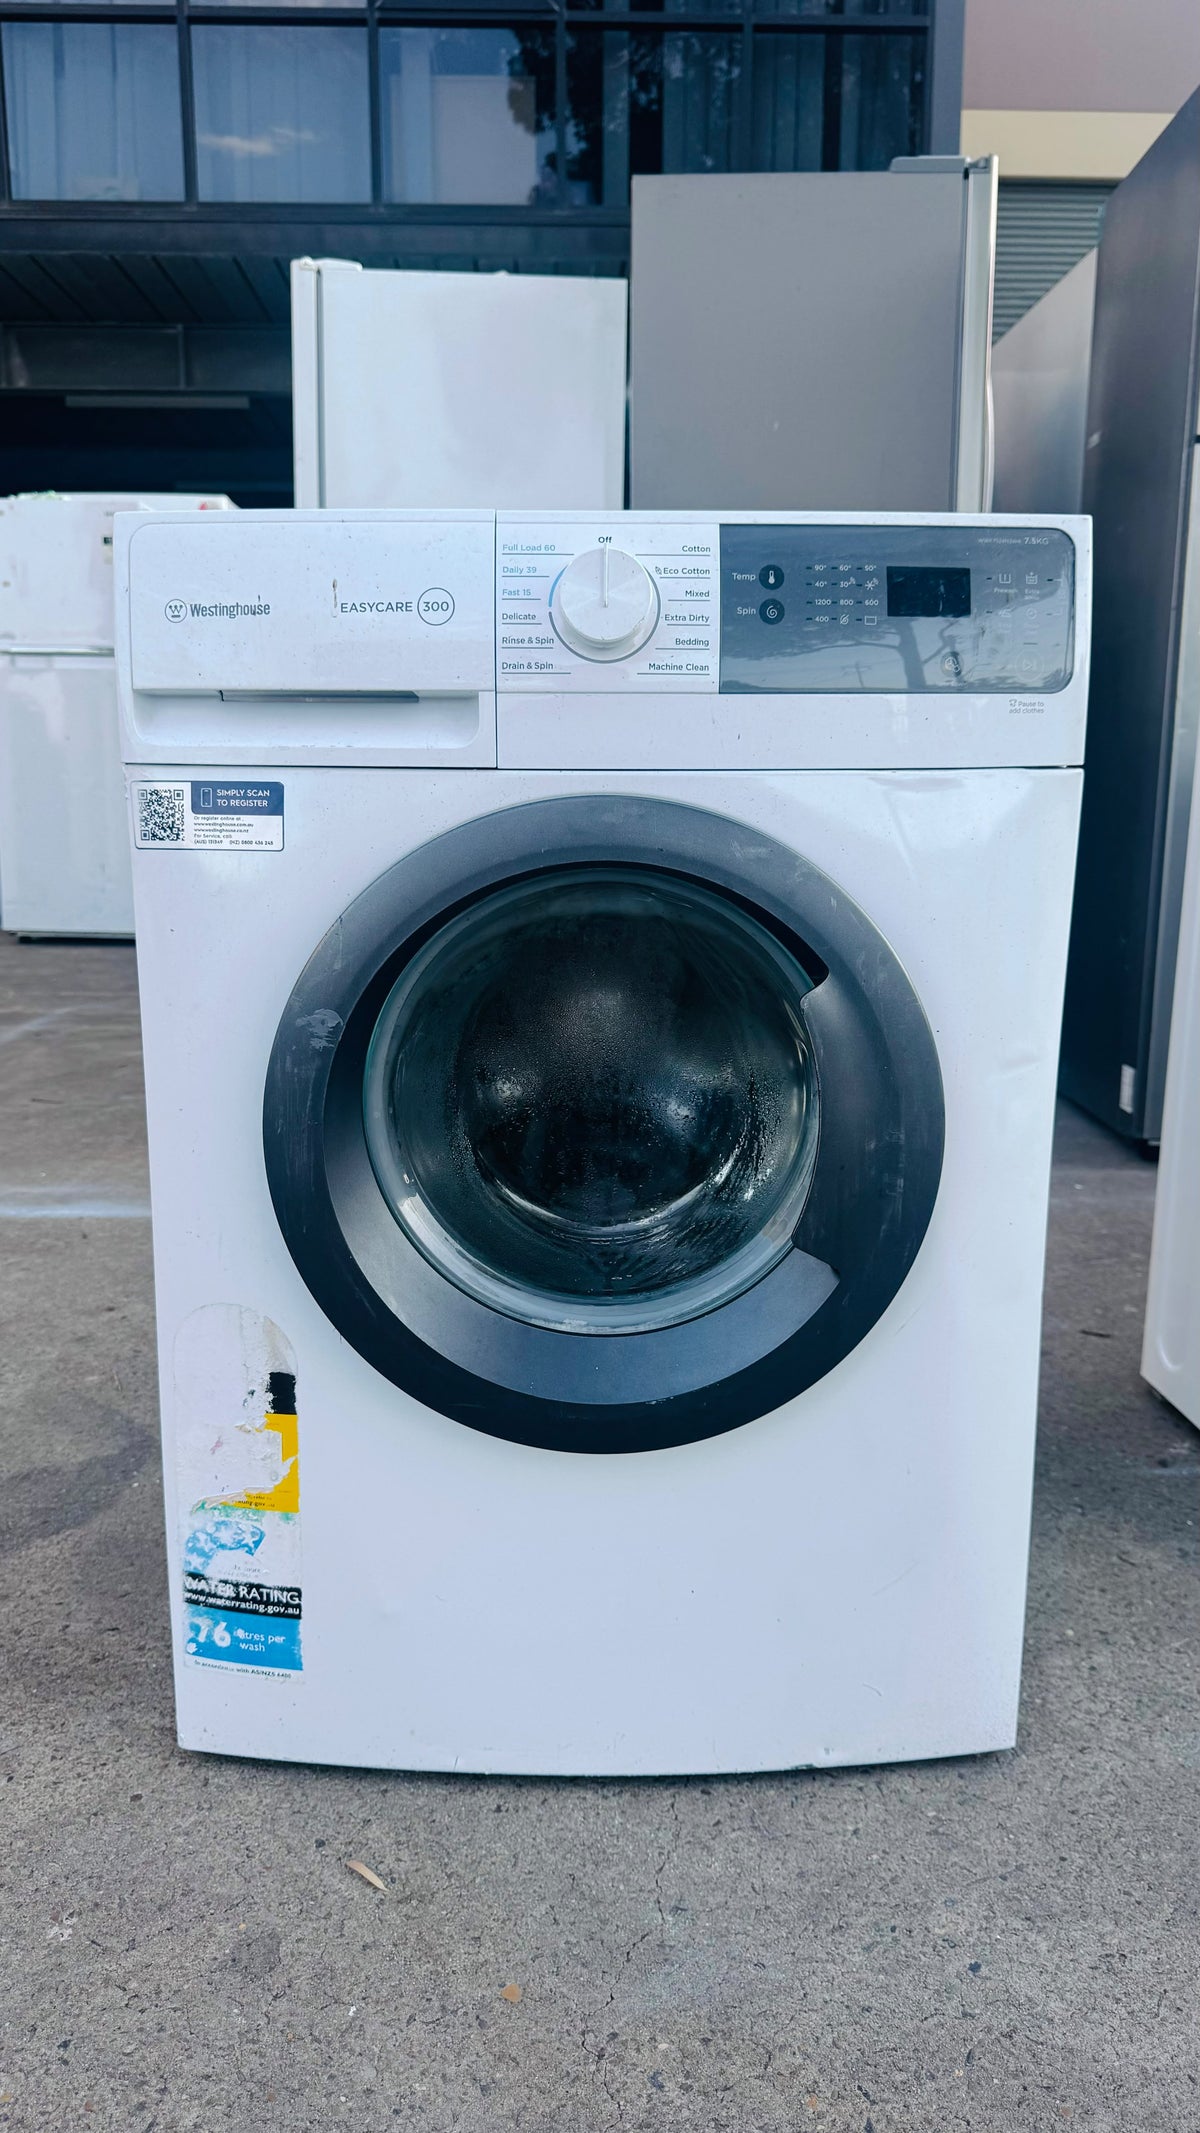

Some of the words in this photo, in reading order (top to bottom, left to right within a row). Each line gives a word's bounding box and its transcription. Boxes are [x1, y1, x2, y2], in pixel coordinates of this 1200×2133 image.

[598, 536, 612, 544] Off
[1024, 536, 1049, 545] 7.5KG
[682, 544, 711, 553] Cotton
[502, 566, 524, 574] Daily
[681, 567, 711, 575] Cotton
[732, 572, 756, 581] Temp
[685, 590, 710, 598] Mixed
[190, 602, 271, 619] Westinghouse
[340, 602, 413, 613] EASYCARE
[422, 600, 450, 612] 300
[736, 606, 756, 616] Spin
[664, 614, 687, 622] Extra
[688, 614, 710, 623] Dirty
[502, 636, 526, 644] Rinse
[528, 636, 534, 644] &
[535, 636, 554, 646] Spin
[676, 638, 710, 648] Bedding
[502, 662, 525, 670] Drain
[526, 662, 533, 670] &
[534, 662, 554, 672] Spin
[648, 663, 684, 671] Machine
[686, 663, 710, 672] Clean
[216, 789, 245, 797] SIMPLY
[246, 789, 270, 797] SCAN
[230, 800, 268, 808] REGISTER
[184, 1576, 236, 1598] WATER
[239, 1586, 300, 1604] RATING
[184, 1592, 300, 1615] www.waterrating.gov.au
[268, 1634, 286, 1644] per
[240, 1642, 266, 1652] wash
